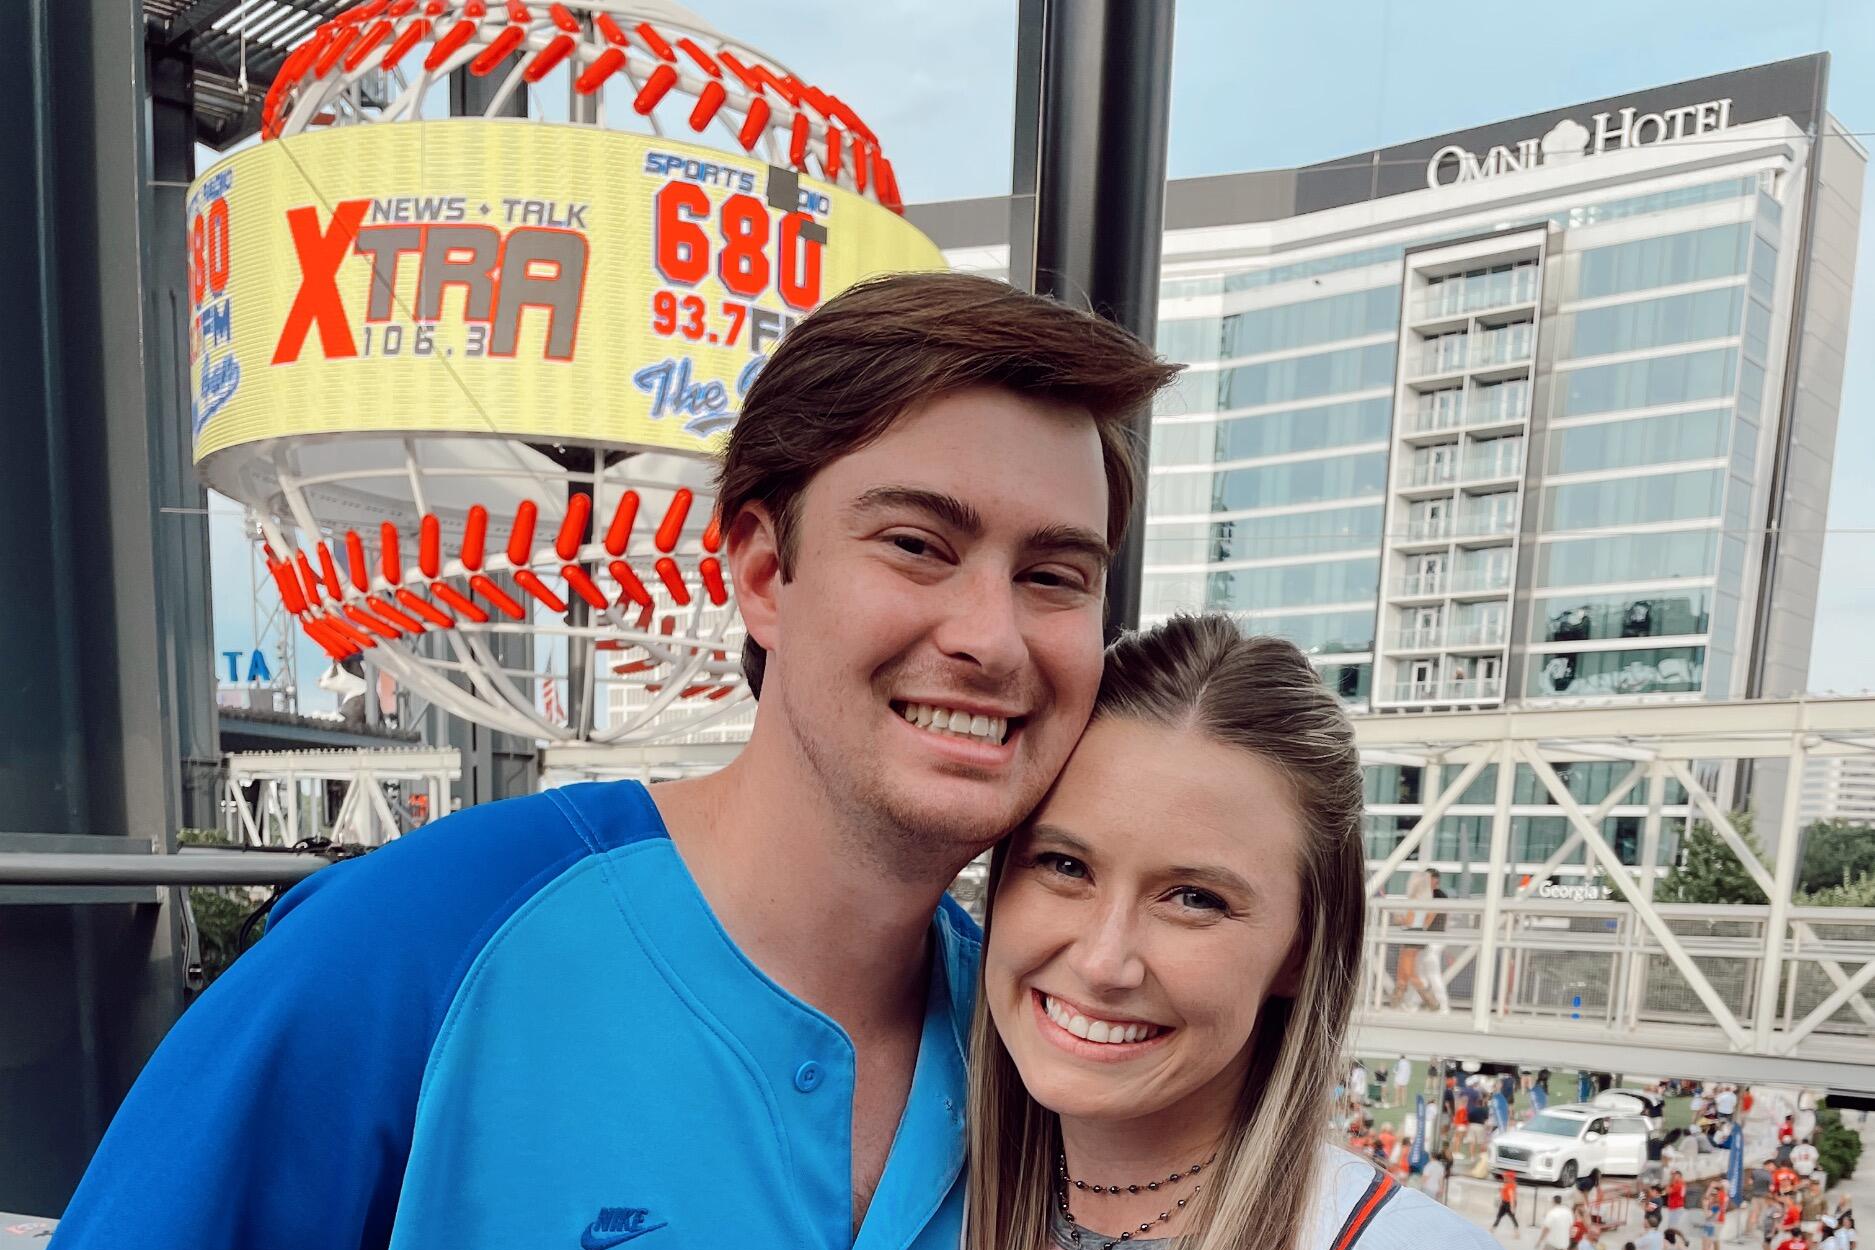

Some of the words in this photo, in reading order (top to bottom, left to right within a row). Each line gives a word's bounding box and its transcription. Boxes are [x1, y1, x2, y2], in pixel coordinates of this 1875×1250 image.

[645, 152, 756, 192] SPORTS
[372, 198, 466, 223] NEWS
[501, 199, 589, 229] TALK
[655, 180, 823, 313] 680
[270, 199, 591, 366] XTRA
[362, 325, 487, 358] 106.3
[632, 356, 729, 418] The
[1539, 880, 1599, 902] Georgia
[592, 1206, 649, 1233] NIKE
